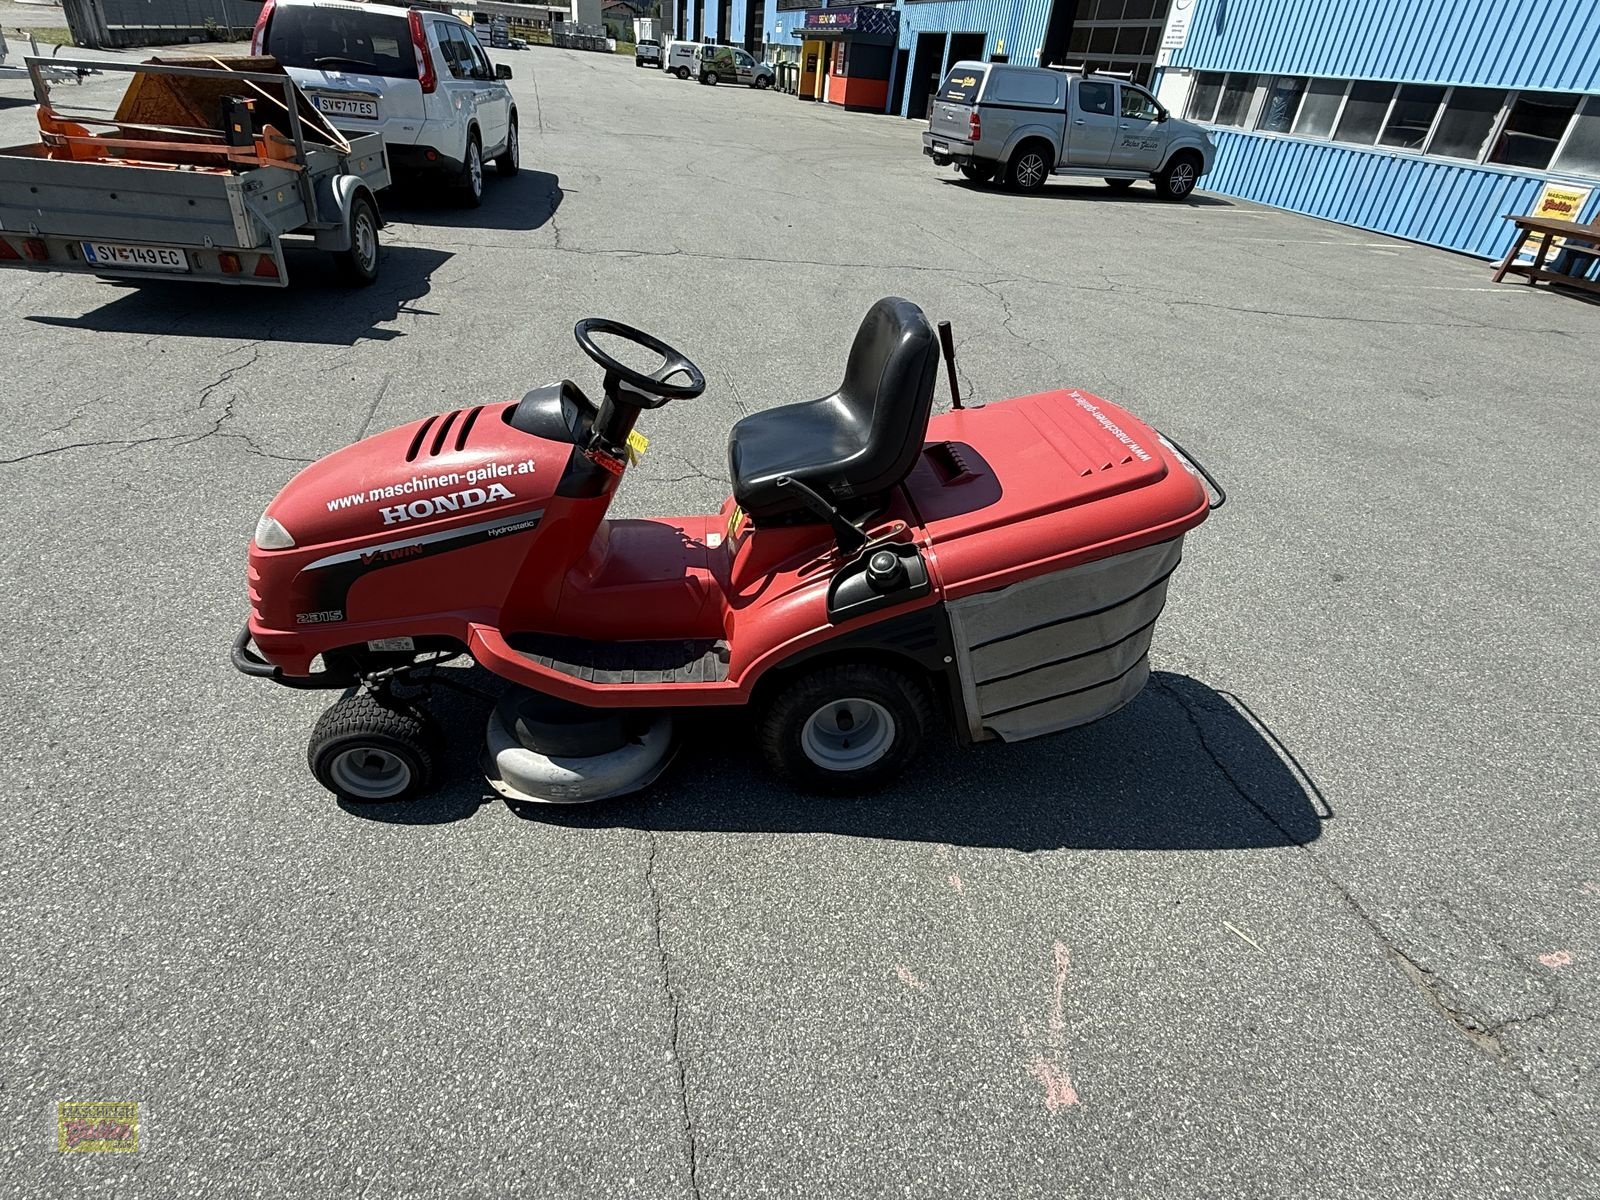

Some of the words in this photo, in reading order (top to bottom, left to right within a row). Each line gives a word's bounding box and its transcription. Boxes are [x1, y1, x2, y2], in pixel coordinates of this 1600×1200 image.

[322, 99, 334, 111] SV
[1547, 192, 1578, 202] MASCHINEN
[97, 246, 117, 261] SV
[129, 248, 157, 264] 149
[158, 250, 180, 265] EC
[1068, 390, 1152, 462] www.maschinen-gailer.at
[326, 459, 536, 512] www.maschinen-gailer.at
[378, 483, 516, 525] HONDA
[487, 519, 535, 537] Hydrostatic
[359, 543, 424, 566] V-TWIN
[295, 610, 344, 624] 2315
